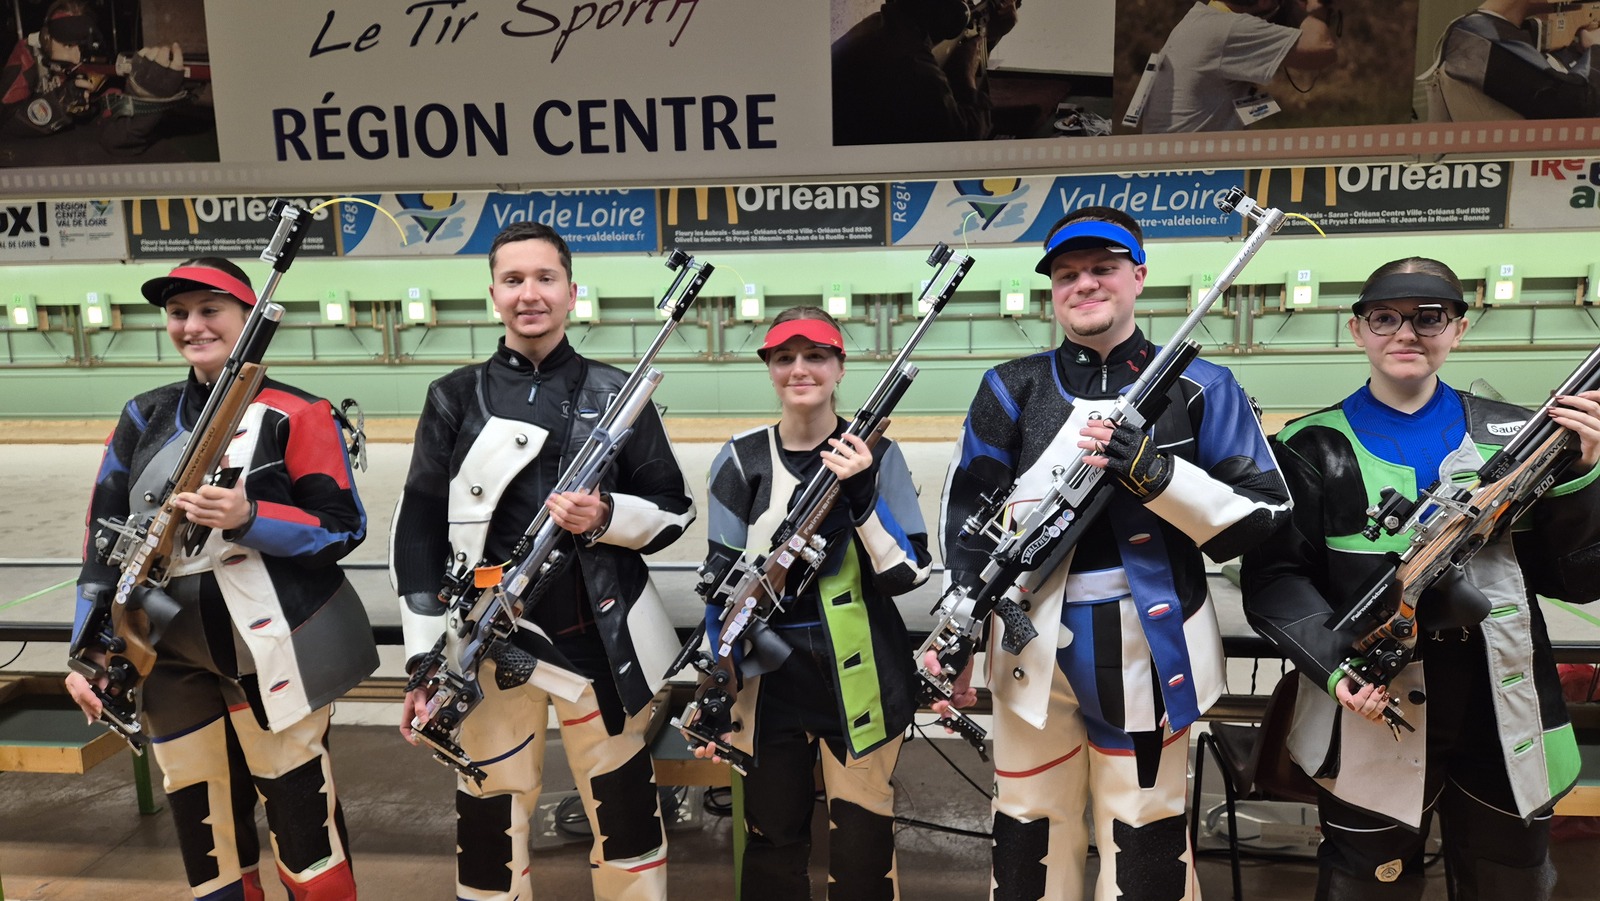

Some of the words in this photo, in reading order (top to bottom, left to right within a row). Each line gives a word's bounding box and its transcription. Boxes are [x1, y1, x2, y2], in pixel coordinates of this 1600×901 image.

[309, 10, 382, 58] Le
[405, 0, 479, 47] Tir
[273, 91, 509, 162] RÉGION
[532, 93, 778, 156] CENTRE
[492, 200, 535, 229] Val
[537, 200, 573, 229] de
[575, 200, 646, 228] Loire
[892, 182, 911, 223] Régi
[1059, 183, 1107, 214] Val
[1109, 182, 1148, 212] de
[1490, 424, 1521, 434] Saue
[1530, 434, 1570, 473] Feinwer
[1534, 474, 1556, 498] 800
[803, 482, 840, 535] Feinwerkb
[811, 550, 827, 570] 800
